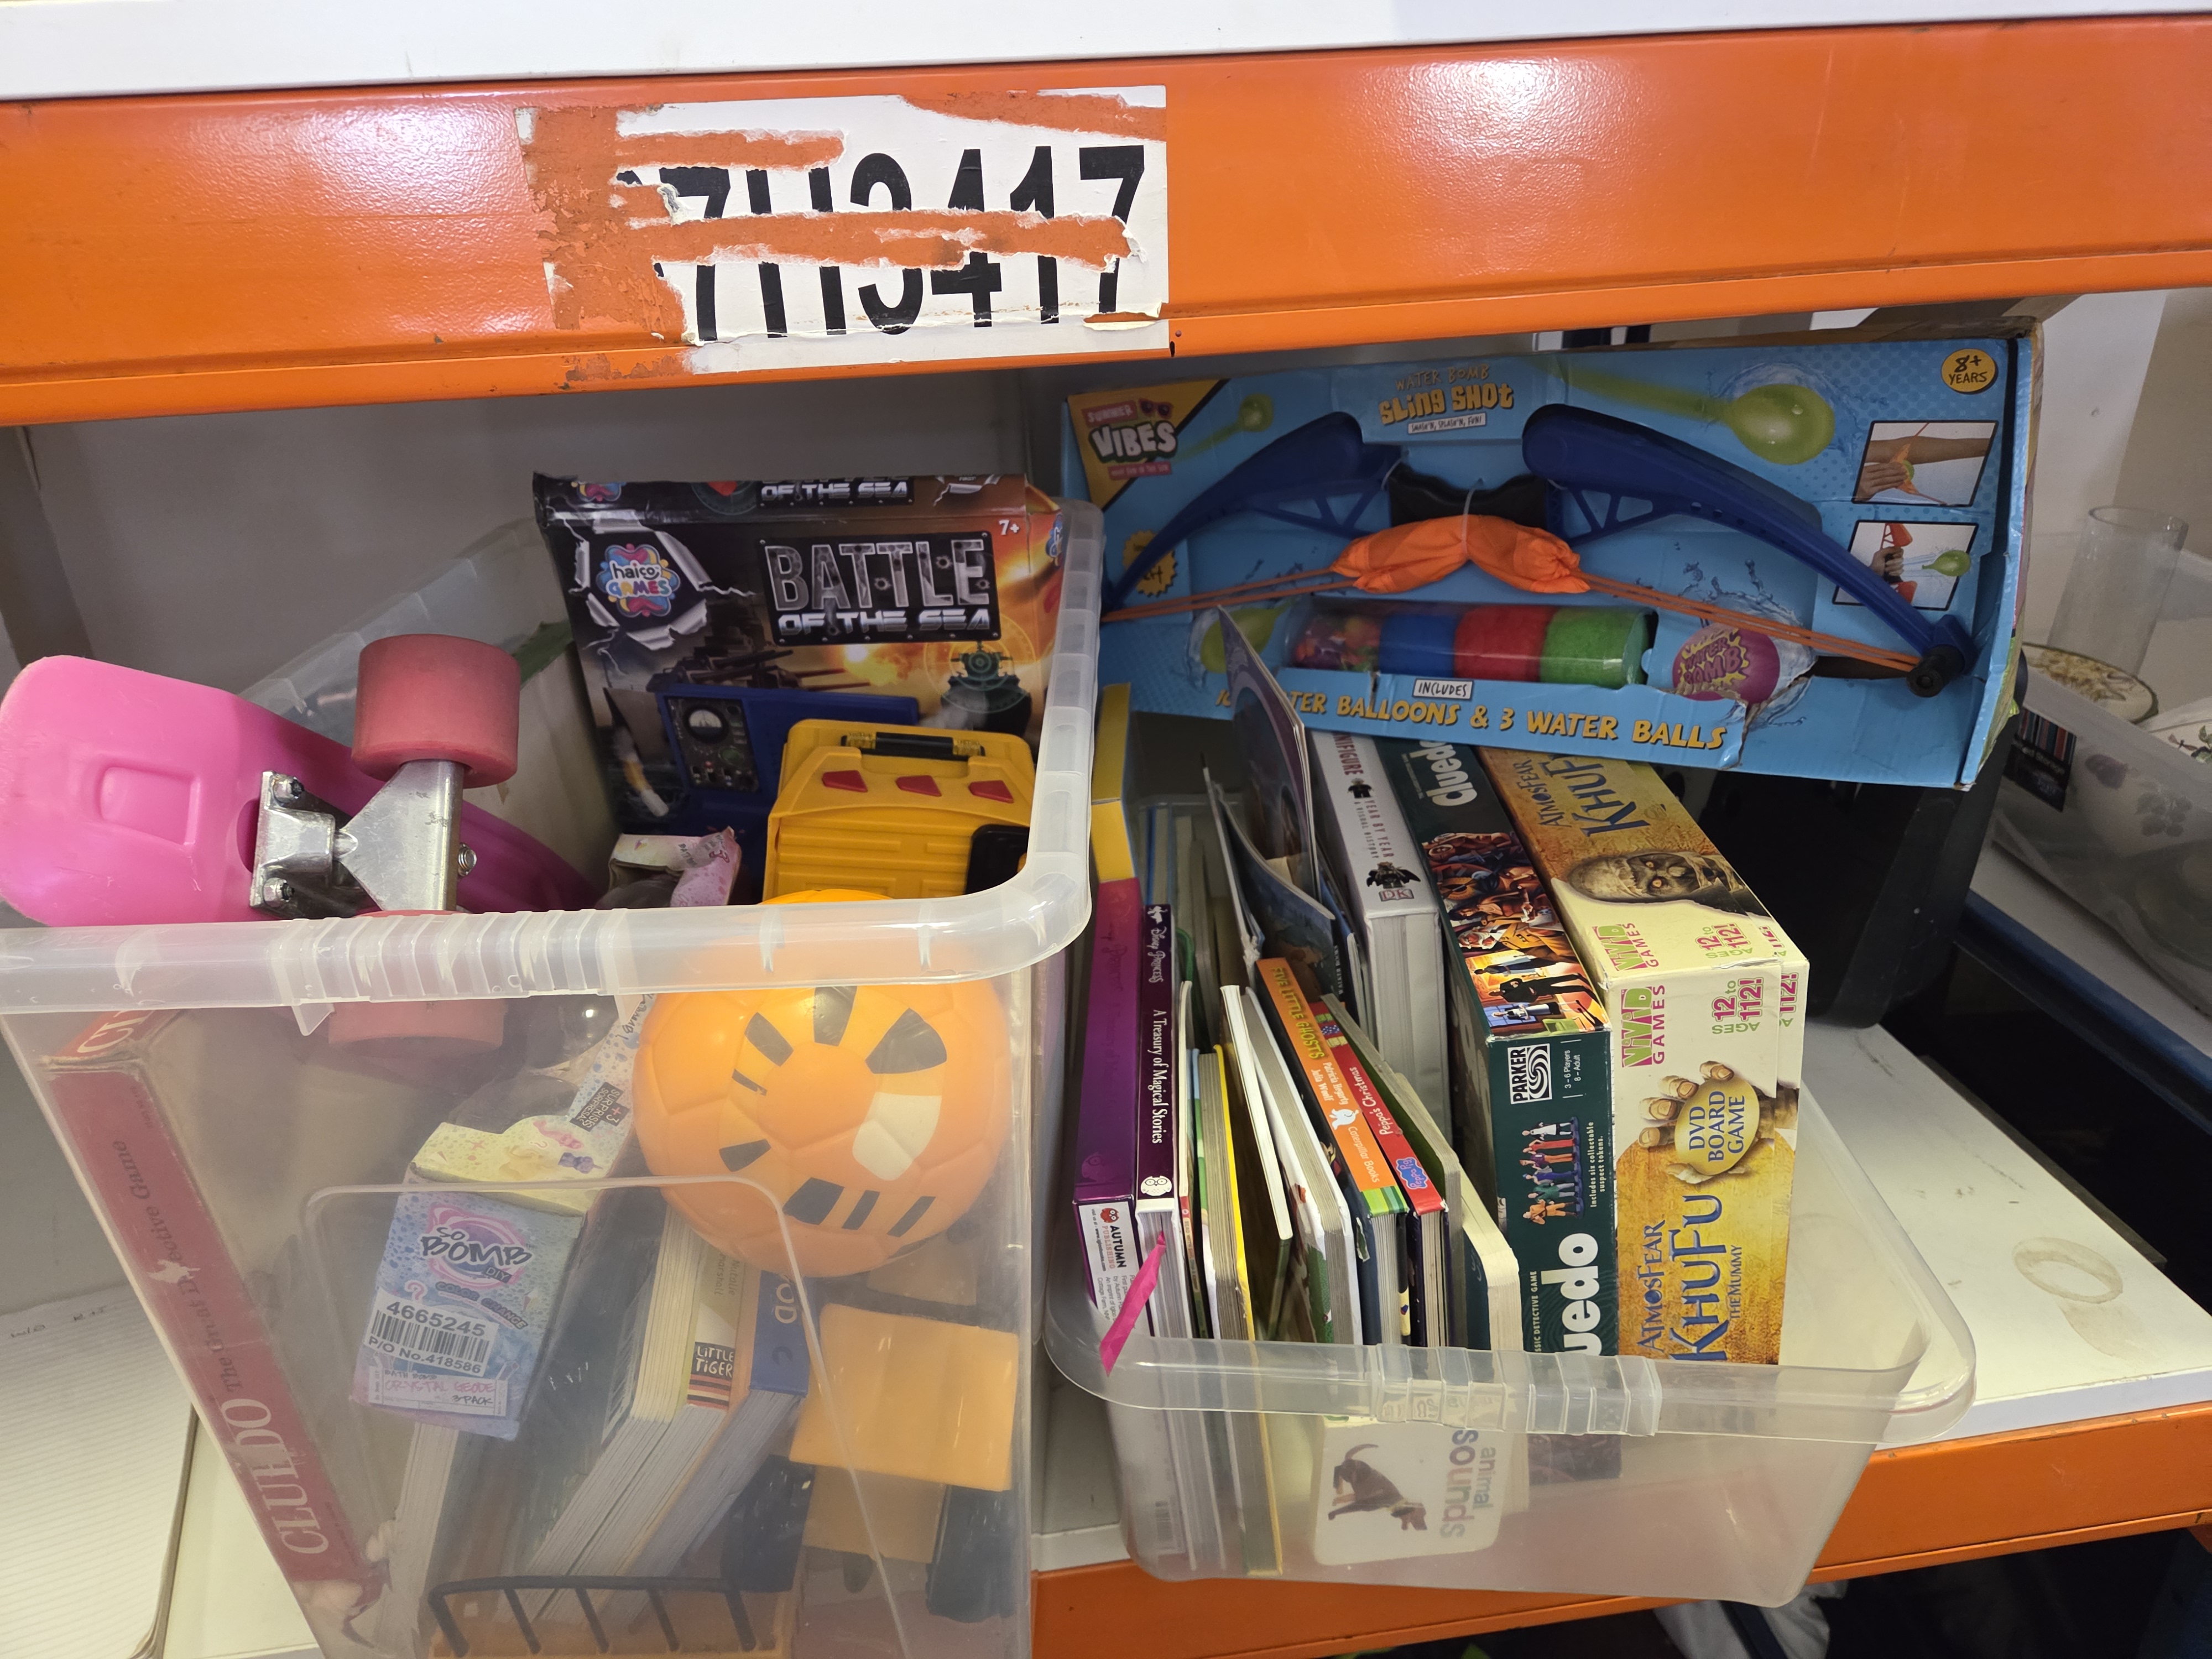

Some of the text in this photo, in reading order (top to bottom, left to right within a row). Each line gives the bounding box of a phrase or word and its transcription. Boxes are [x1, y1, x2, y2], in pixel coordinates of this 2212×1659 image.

[1395, 363, 1490, 391] WATER BOMB
[1948, 371, 1988, 385] YEARS
[1954, 354, 1983, 373] 8+
[1091, 421, 1177, 458] VIBES
[761, 480, 908, 501] OF THE SEA
[998, 518, 1021, 535] 7+
[608, 579, 671, 597] GAMES
[612, 560, 660, 580] haico
[764, 538, 992, 612] BATTLE
[778, 608, 992, 636] OF THE SEA
[1417, 681, 1468, 697] INCLUDES
[1337, 695, 1461, 726] BALLOONS
[1469, 705, 1489, 729] &
[1499, 708, 1515, 731] 3
[1526, 709, 1618, 740] WATER
[1632, 719, 1728, 749] BALLS
[1512, 758, 1573, 828] ATMOSFEAR
[1382, 888, 1411, 900] DK
[1621, 922, 1660, 968] GAMES
[1696, 926, 1724, 952] 12 to
[1705, 947, 1754, 959] AGES
[1714, 922, 1749, 949] 112!
[1269, 965, 1327, 1060] FIVE LITTLE GHOSTS
[1713, 979, 1737, 1021] 12 to
[1738, 978, 1764, 1021] 112!
[1147, 1018, 1167, 1055] Treasury
[1652, 984, 1666, 1065] GAMES
[1712, 1021, 1761, 1035] AGES
[1152, 1057, 1170, 1068] of
[1311, 1068, 1322, 1084] Julia
[1322, 1061, 1338, 1087] Patricia
[1510, 1047, 1528, 1102] PARKER
[1562, 1050, 1572, 1073] Players
[1572, 1053, 1582, 1071] Adult
[1147, 1070, 1170, 1107] Magical
[1349, 1066, 1394, 1135] Peppa's Christmas
[582, 1089, 620, 1128] SURPRISES
[605, 1114, 620, 1123] 3
[1152, 1109, 1168, 1144] Stories
[1708, 1091, 1725, 1162] BOARD
[1727, 1095, 1745, 1154] GAME
[1585, 1121, 1596, 1164] collectable
[1688, 1106, 1706, 1151] DVD
[111, 1140, 150, 1200] Game
[1348, 1126, 1381, 1183] Caterpillar Books
[1595, 1135, 1606, 1193] suspect tokens.
[1400, 1159, 1428, 1188] Peppa Pig
[1589, 1181, 1598, 1208] Includes
[420, 1235, 534, 1267] BOMB
[436, 1225, 466, 1241] SO
[1101, 1225, 1116, 1270] PUBLISHING
[1110, 1225, 1127, 1268] AUTUMN
[486, 1266, 509, 1281] DIY
[1530, 1271, 1538, 1293] GAME
[1636, 1219, 1666, 1354] ATMOSFEAR
[1668, 1194, 1729, 1361] KHUFU
[1726, 1244, 1743, 1320] THE MUMMY
[387, 1300, 487, 1337] 4665245
[435, 1281, 481, 1302] COLOR
[480, 1297, 529, 1330] CHANGE
[1531, 1296, 1541, 1334] DETECTIVE
[368, 1335, 482, 1375] P/O No.418586
[384, 1379, 448, 1394] CRYSTAL
[453, 1381, 495, 1394] GEODE
[1439, 1429, 1479, 1540] sounds
[1472, 1446, 1497, 1510] animal
